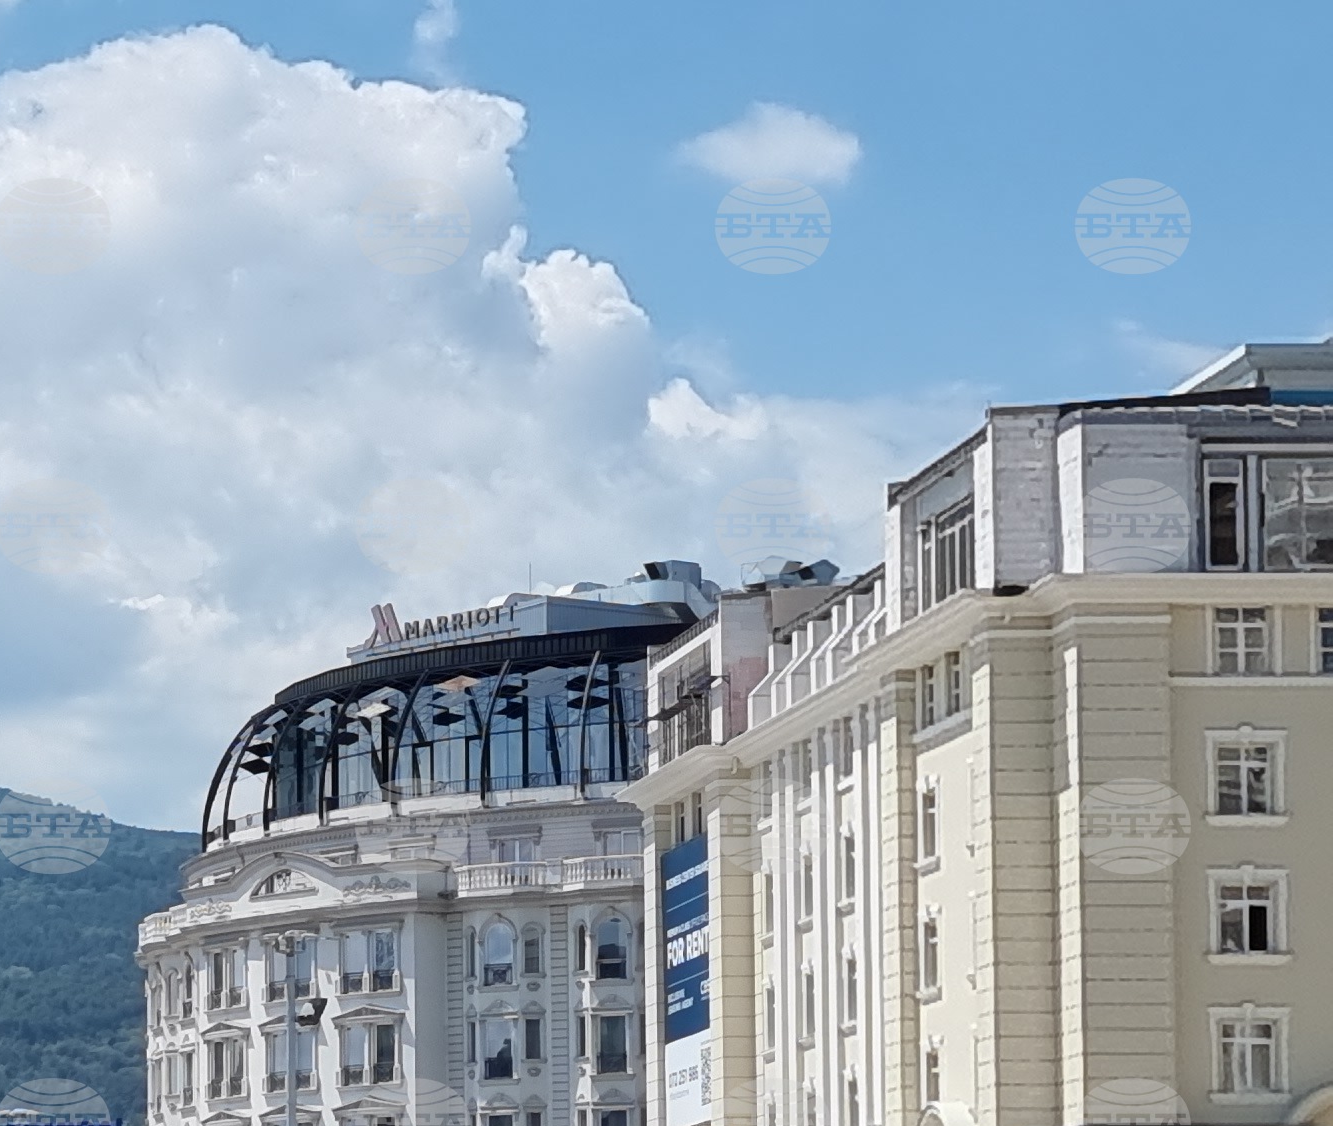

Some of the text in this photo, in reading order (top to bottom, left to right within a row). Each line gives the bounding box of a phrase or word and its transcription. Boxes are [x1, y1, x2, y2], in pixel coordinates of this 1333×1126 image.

[404, 605, 515, 641] MARRIOTT
[667, 925, 709, 970] FOR RENT
